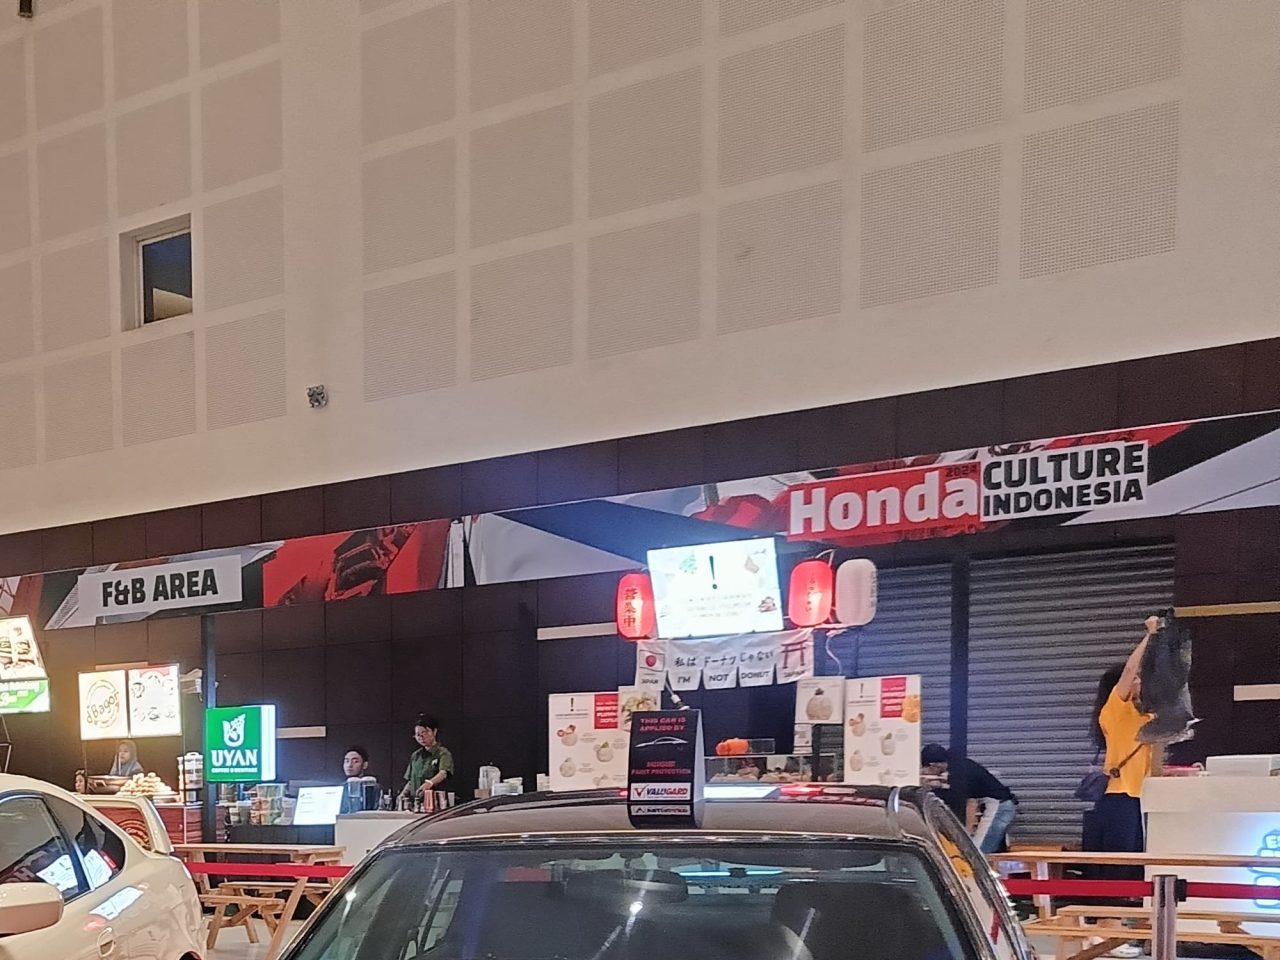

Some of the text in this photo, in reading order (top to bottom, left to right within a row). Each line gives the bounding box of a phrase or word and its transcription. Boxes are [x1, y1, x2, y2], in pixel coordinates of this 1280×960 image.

[983, 444, 1145, 490] CULTURE
[788, 471, 977, 535] Honda
[982, 478, 1144, 517] INDONESIA
[102, 568, 219, 608] F&B AREA
[708, 674, 729, 683] NOT
[211, 748, 258, 767] UYAN
